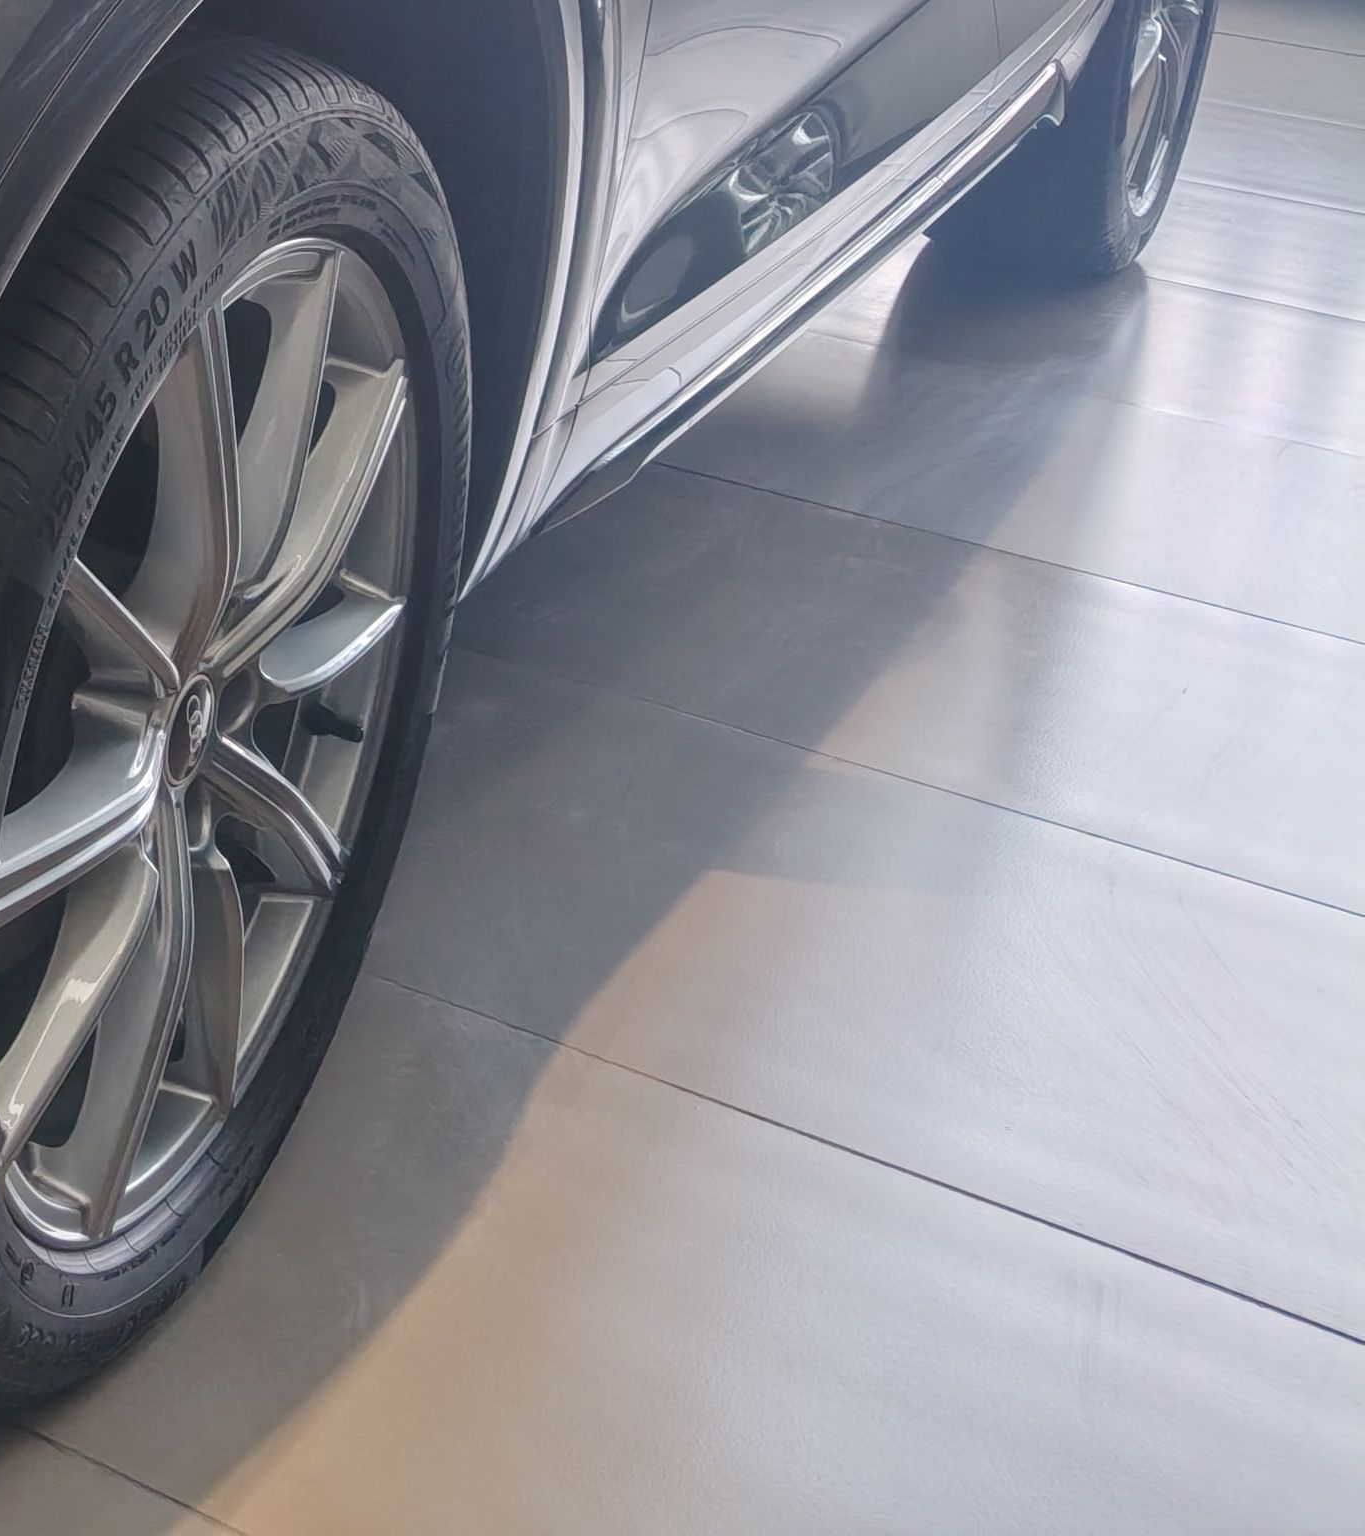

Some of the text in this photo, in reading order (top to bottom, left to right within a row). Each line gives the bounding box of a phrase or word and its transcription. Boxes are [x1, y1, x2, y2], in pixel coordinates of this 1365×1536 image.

[114, 341, 139, 385] R
[135, 286, 170, 354] 20
[170, 240, 198, 294] W
